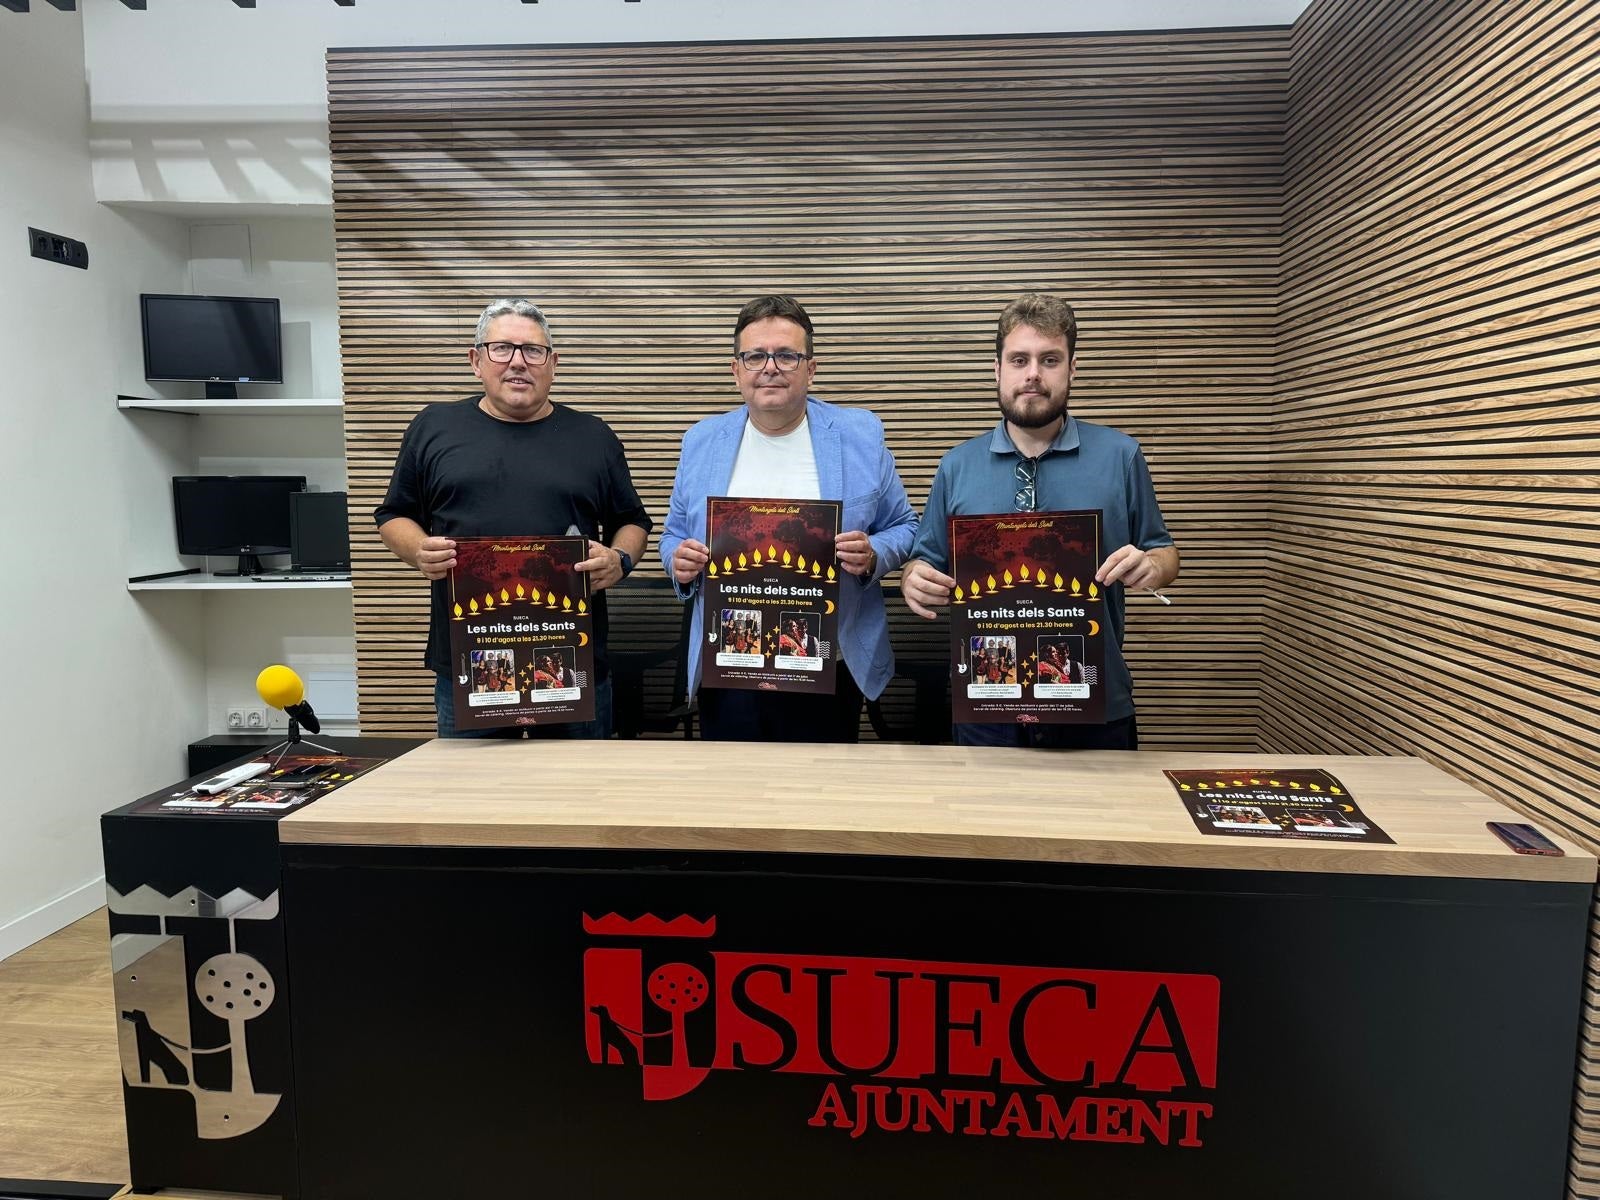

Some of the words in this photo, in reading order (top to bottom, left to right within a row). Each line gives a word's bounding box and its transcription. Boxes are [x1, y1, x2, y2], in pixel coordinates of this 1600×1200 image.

[720, 584, 738, 593] Les
[740, 584, 762, 594] nits
[764, 585, 788, 595] dels
[790, 586, 823, 596] Sants
[968, 609, 988, 619] Les
[991, 608, 1014, 618] nits
[1017, 608, 1044, 618] dels
[1047, 607, 1085, 617] Sants
[467, 625, 486, 634] Les
[490, 623, 512, 633] nits
[515, 622, 539, 632] dels
[542, 622, 576, 631] Sants
[731, 963, 1205, 1092] SUECA
[808, 1082, 1213, 1147] AJUNTAMENT
